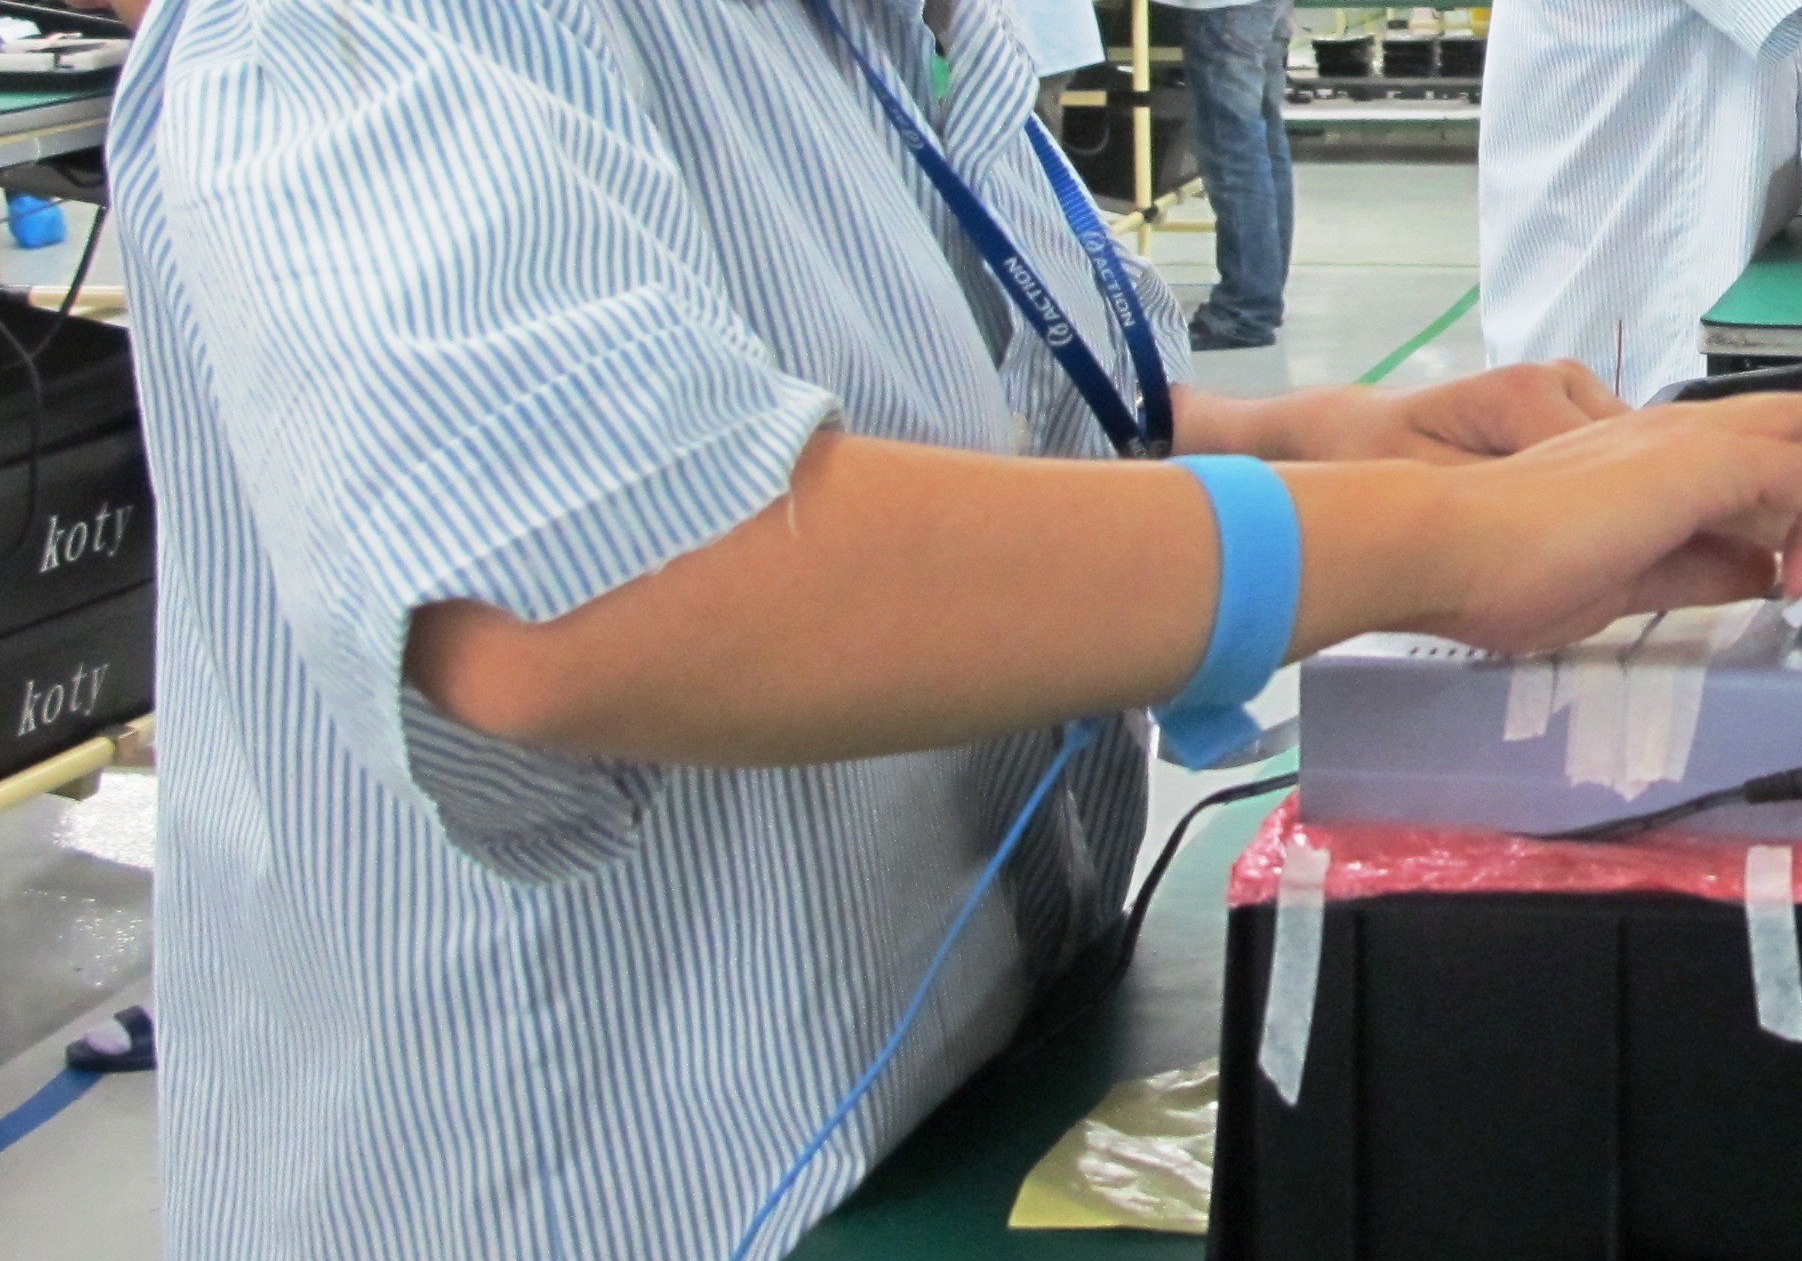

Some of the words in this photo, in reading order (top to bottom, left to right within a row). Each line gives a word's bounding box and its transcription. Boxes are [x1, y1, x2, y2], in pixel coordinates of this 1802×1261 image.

[1003, 256, 1061, 322] ACTION
[1092, 257, 1137, 328] ACTION
[38, 500, 135, 574] koty
[15, 660, 111, 738] koty
